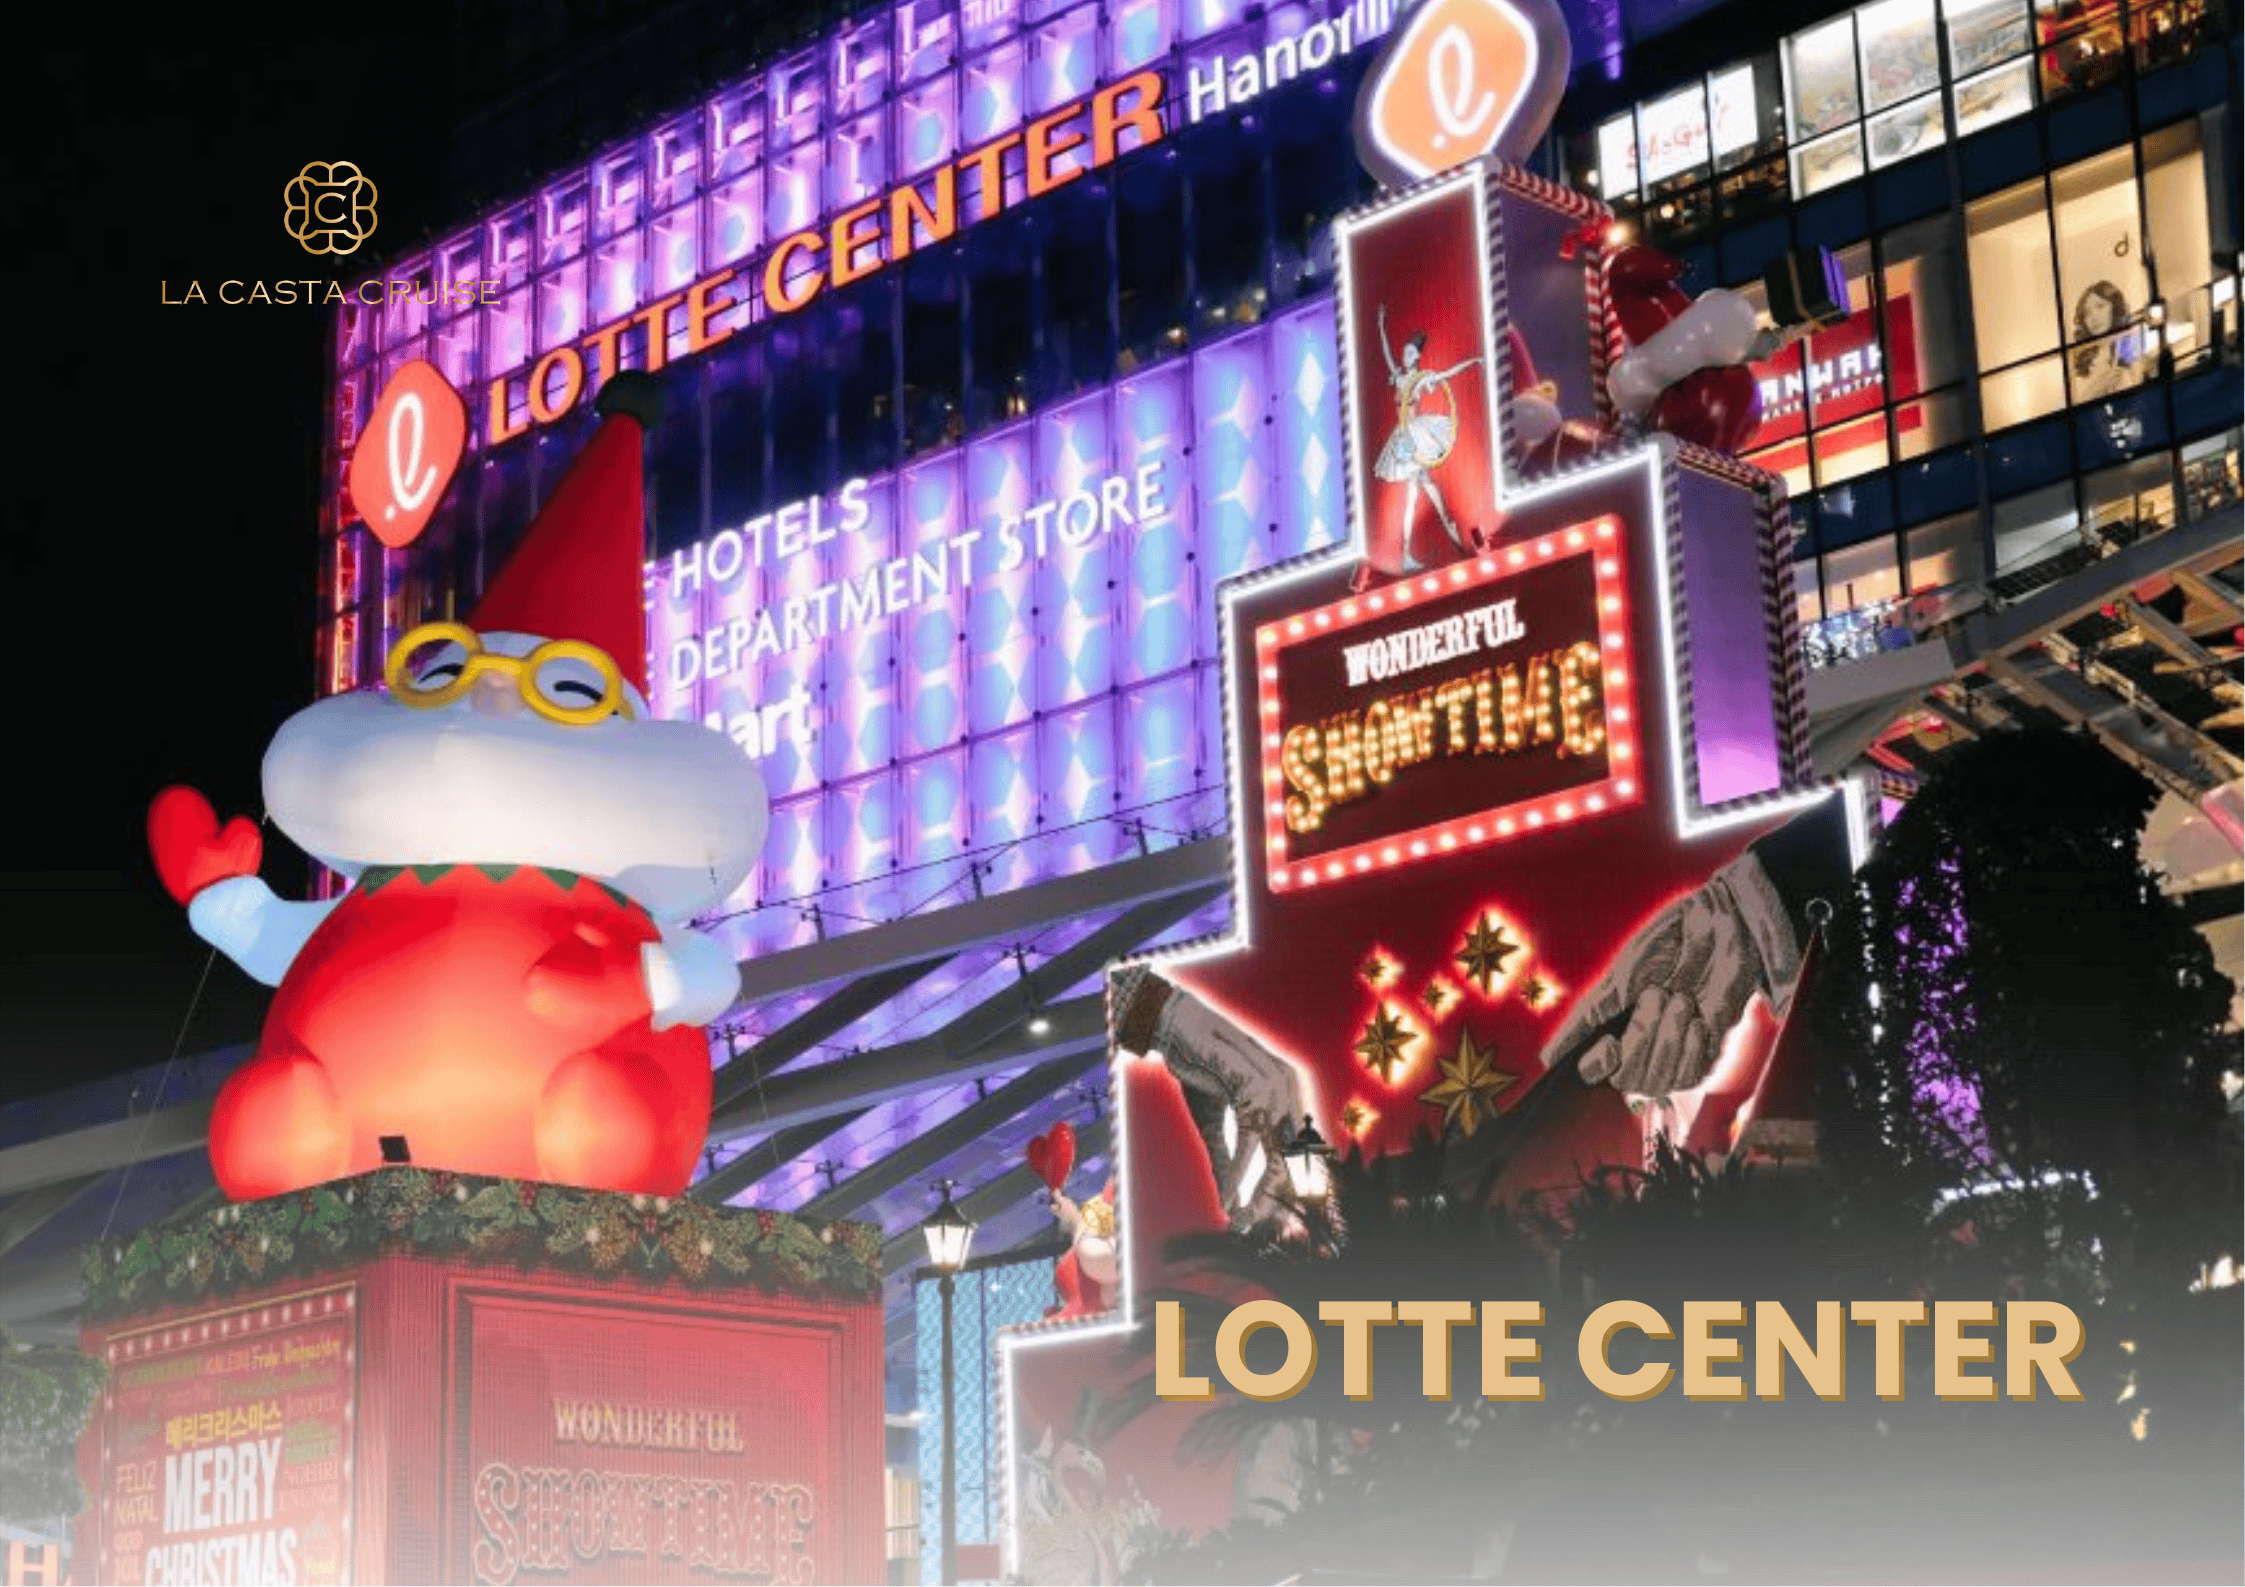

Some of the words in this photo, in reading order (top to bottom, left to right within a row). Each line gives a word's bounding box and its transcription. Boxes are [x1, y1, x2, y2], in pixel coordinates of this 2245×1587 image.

[489, 268, 736, 446] LOTTE
[763, 69, 1166, 315] CENTER
[671, 529, 982, 691] DEPARTMENT
[998, 461, 1168, 574] STORE
[672, 478, 870, 599] HOTELS
[1342, 597, 1525, 688] WONDERFUL
[1281, 640, 1607, 833] SHOWTIME
[116, 1460, 158, 1494] FELIZ
[553, 1397, 745, 1455] WONDERFUL
[163, 1437, 282, 1535] MERRY
[473, 1462, 817, 1587] SHOWTIME
[145, 1527, 298, 1587] CHRISTMAS
